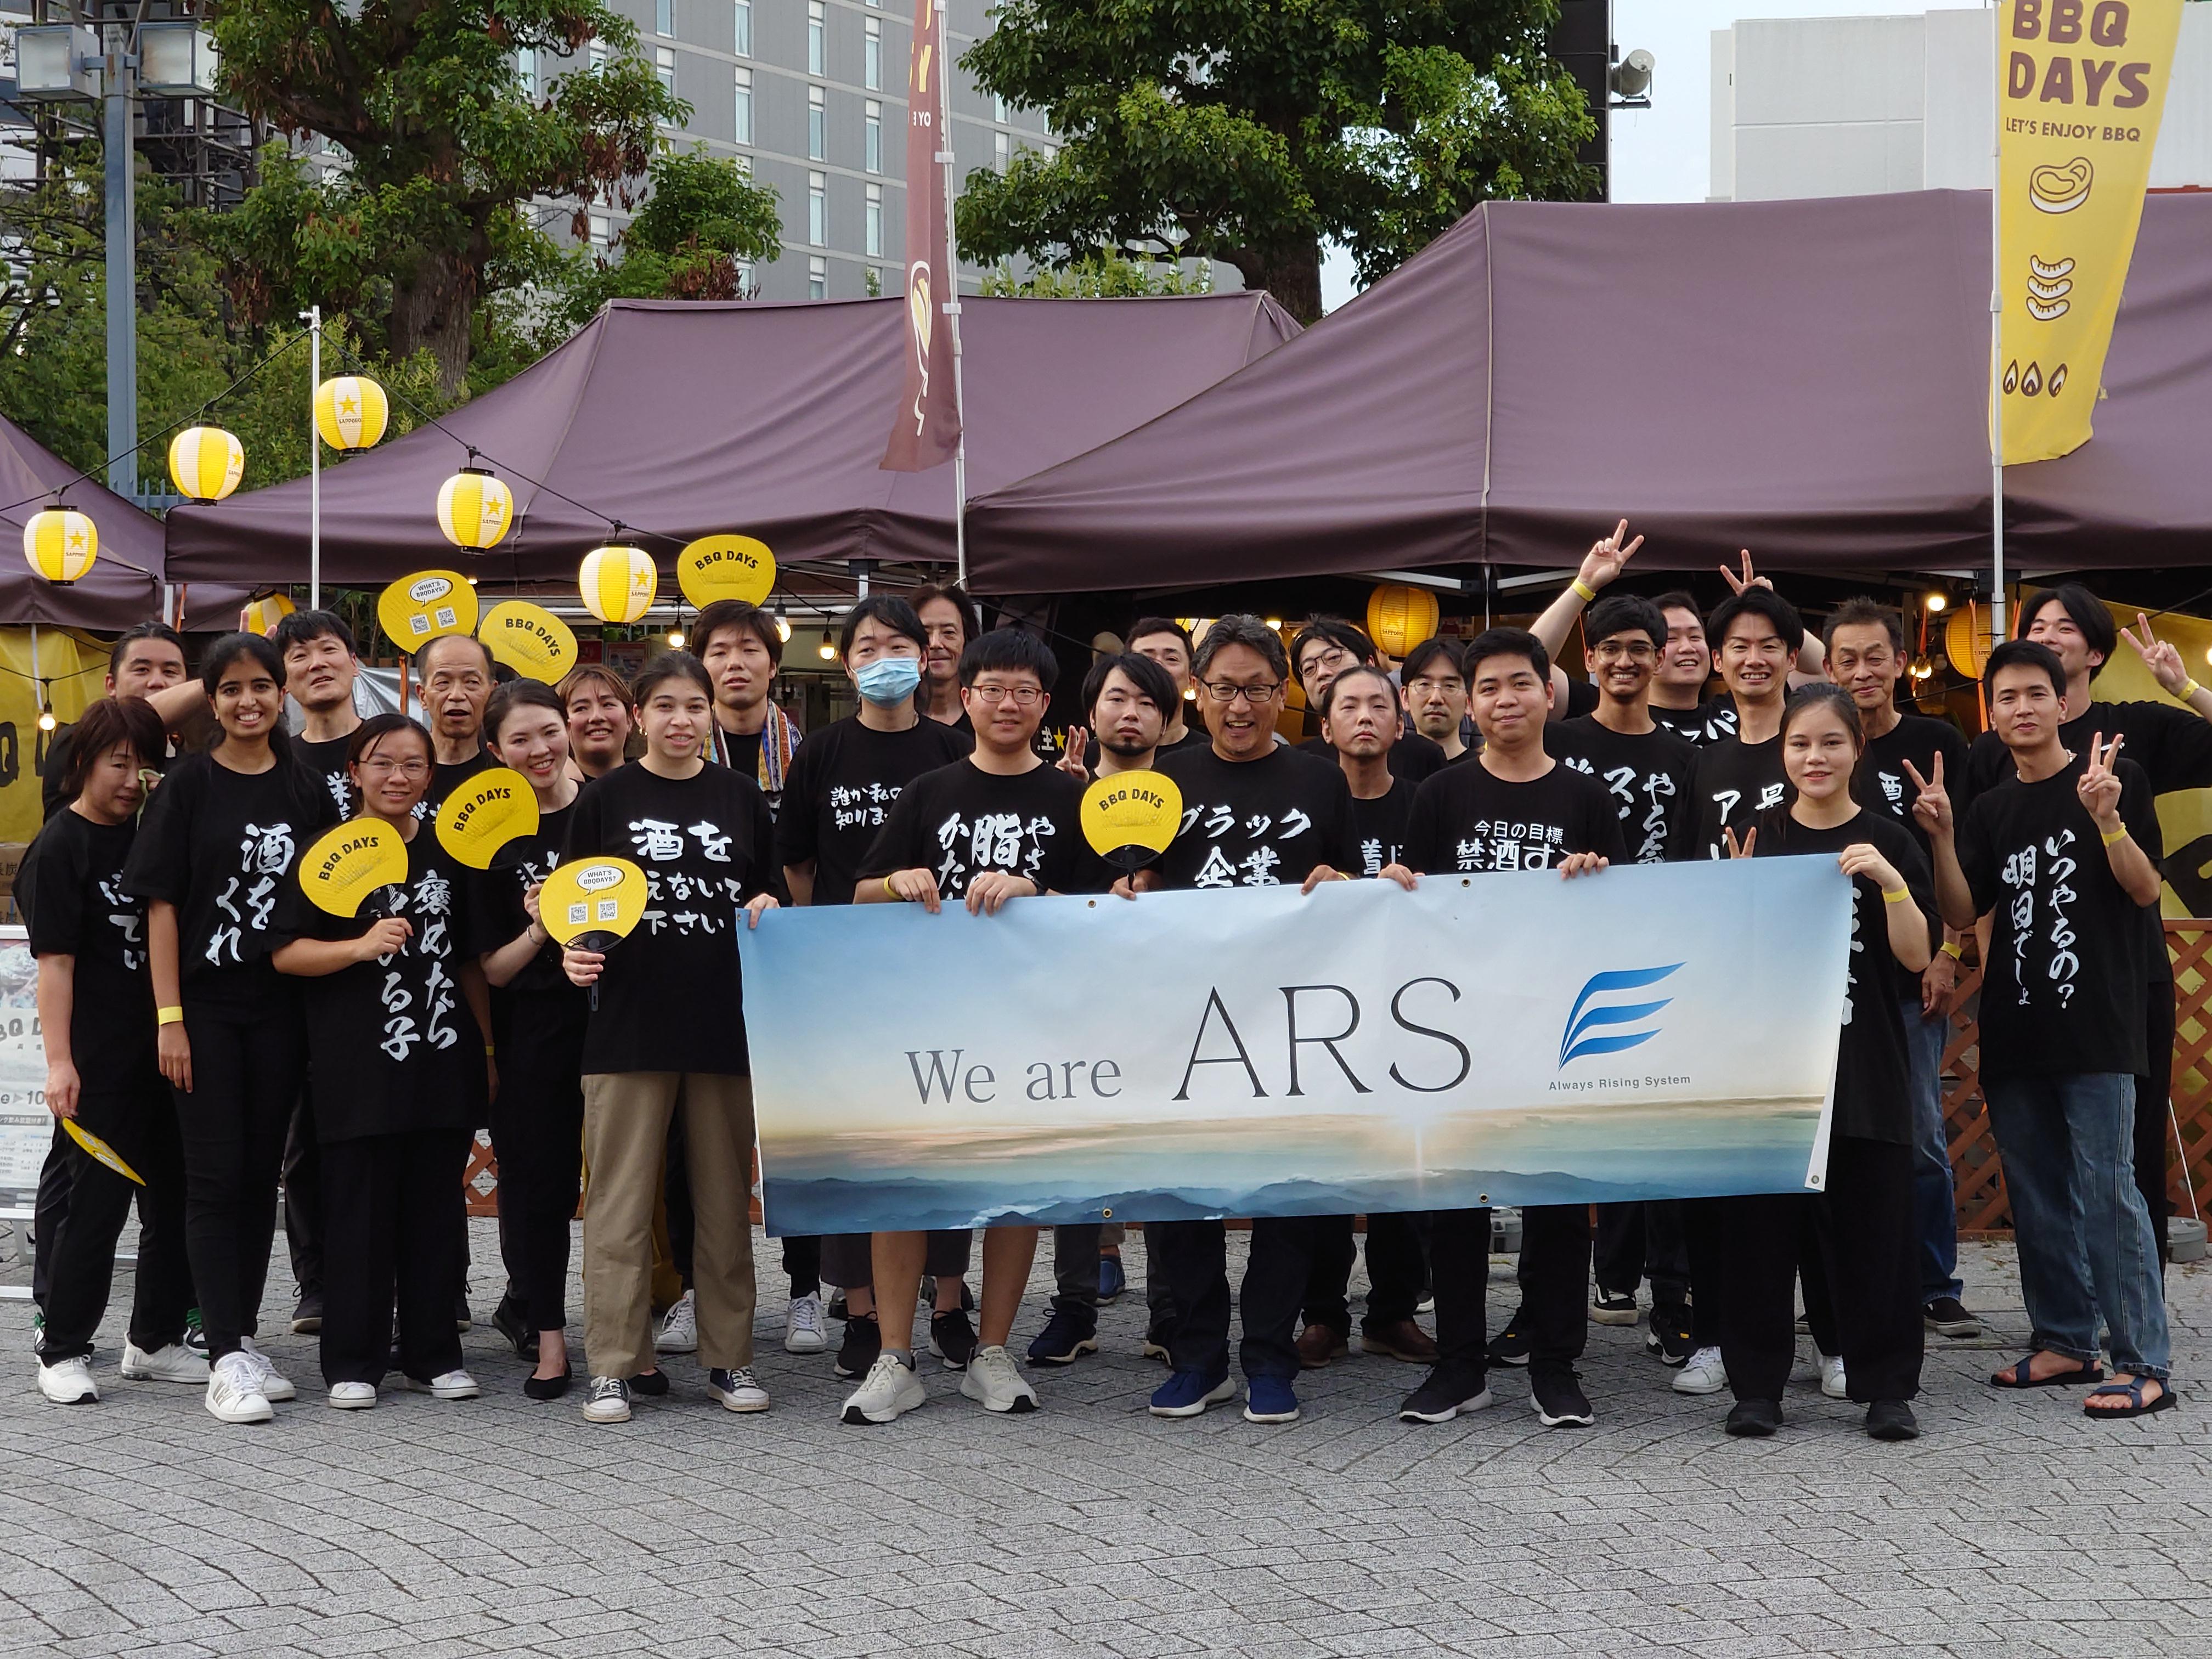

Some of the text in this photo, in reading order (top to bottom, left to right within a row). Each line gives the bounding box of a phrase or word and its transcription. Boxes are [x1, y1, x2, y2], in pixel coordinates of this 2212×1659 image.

[2013, 0, 2129, 47] BBQ
[2008, 51, 2151, 108] DAYS
[2006, 117, 2141, 142] LET'S ENJOY BBQ
[695, 551, 759, 570] BBQ DAYS
[416, 586, 445, 597] BBQDAYS?
[418, 582, 440, 591] WHAT'S
[506, 618, 561, 657] BBQ DAYS
[454, 803, 476, 831] BBQ
[476, 788, 511, 805] DAYS
[1099, 788, 1164, 811] BBQ DAYS
[836, 807, 888, 831] 知りま
[1176, 805, 1311, 839] ブラック
[1474, 820, 1564, 845] 今日の目標
[628, 819, 732, 862] 酒を
[240, 823, 295, 929] 酒を
[318, 837, 379, 881] BBQ DAYS
[588, 870, 612, 878] WHAT'S
[1194, 845, 1281, 888] 企業
[584, 876, 617, 885] BBQDAYS?
[205, 877, 244, 966] くれ
[641, 910, 725, 935] 下さい
[2002, 844, 2037, 1005] 明日でしょ
[904, 978, 1471, 1105] We are ARS
[1549, 1076, 1690, 1091] Always Rising System
